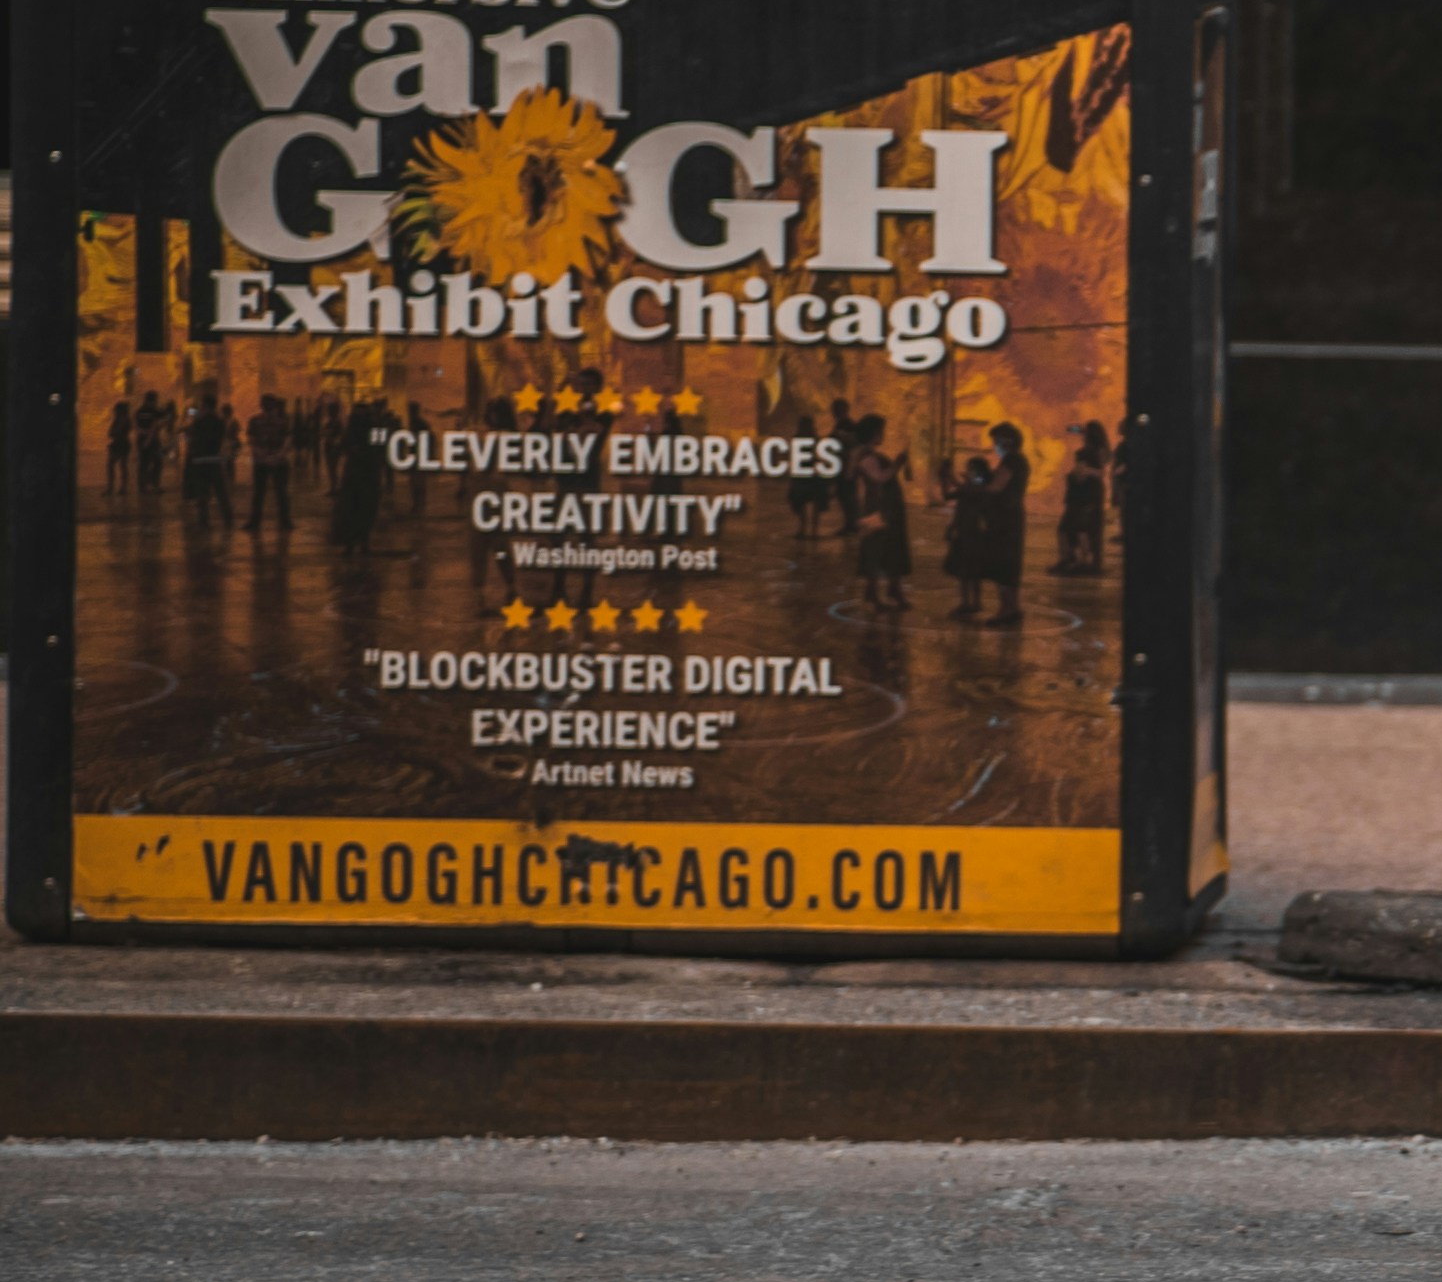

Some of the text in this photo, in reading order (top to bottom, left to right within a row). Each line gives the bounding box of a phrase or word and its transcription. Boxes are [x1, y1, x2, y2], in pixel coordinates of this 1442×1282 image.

[206, 7, 630, 118] van
[213, 114, 1009, 274] GGH
[210, 270, 1007, 371] Exhibit Chicago
[370, 428, 843, 477] "CLEVERLY EMBRACES
[472, 491, 742, 535] CREATIVITY"
[513, 541, 655, 574] Washington
[662, 544, 718, 571] Post
[364, 648, 842, 695] "BLOCKBUSTER DIGITAL
[471, 709, 736, 750] EXPERIENCE"
[532, 759, 694, 788] Artnet News
